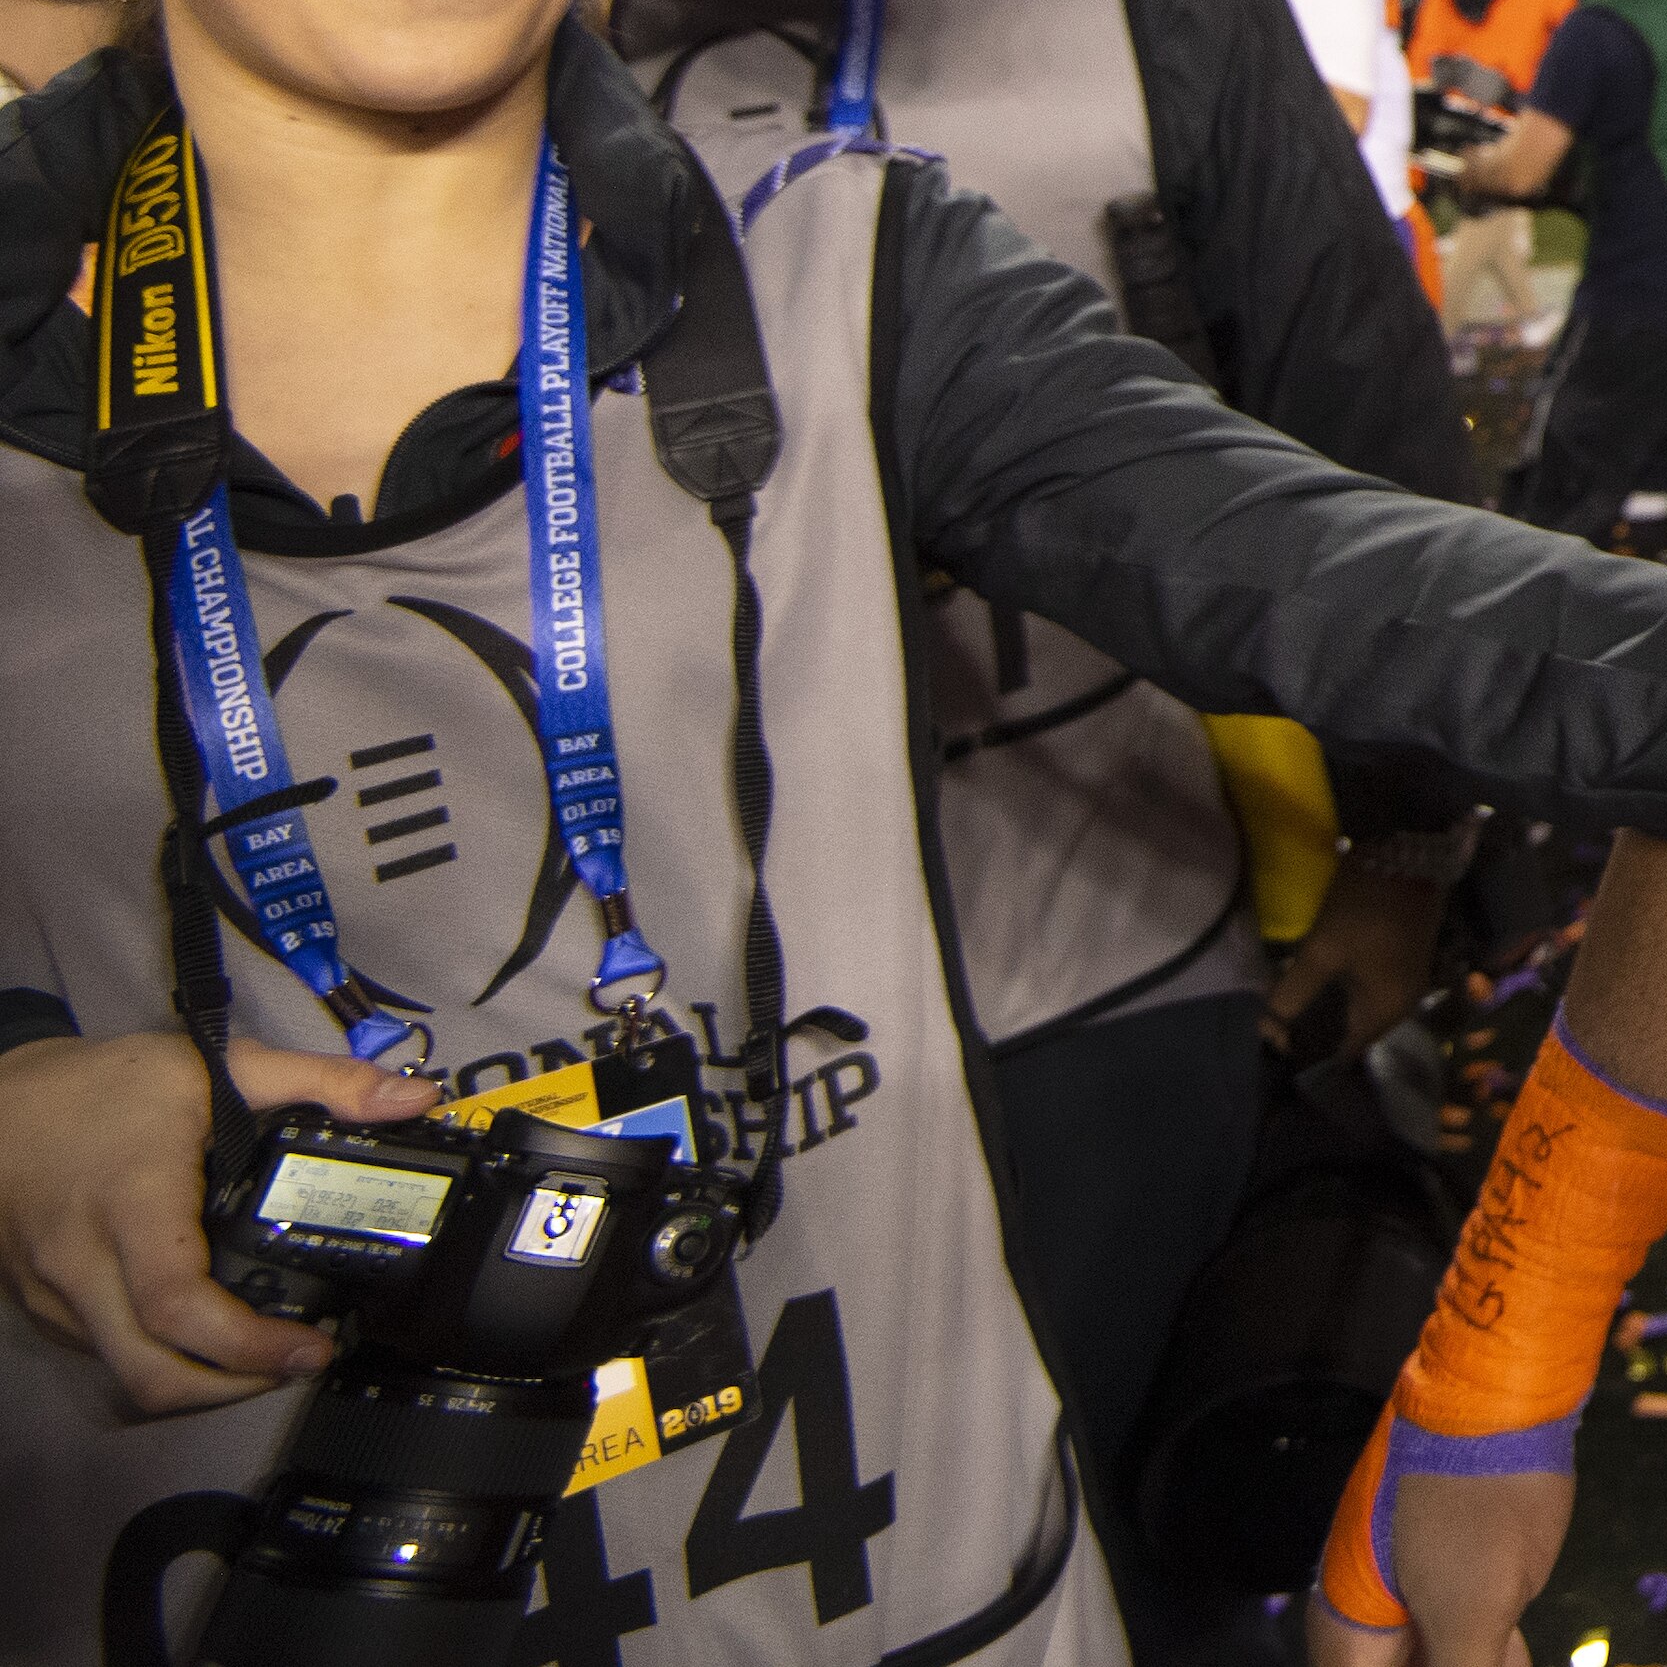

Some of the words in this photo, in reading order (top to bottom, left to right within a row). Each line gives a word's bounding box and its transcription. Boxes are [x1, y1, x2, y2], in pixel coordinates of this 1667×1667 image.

[119, 134, 186, 278] D500
[540, 172, 570, 282] NATIONAL
[132, 283, 180, 397] Nikon
[540, 282, 572, 392] PLAYOFF
[541, 395, 580, 547] FOOTBALL
[550, 550, 588, 693] COLLEGE
[190, 546, 269, 781] CHAMPIONSHIP
[556, 732, 600, 754] BAY
[555, 765, 616, 790] AREA
[562, 796, 618, 823] 01.07
[247, 823, 293, 852] BAY
[571, 827, 622, 856] 219
[253, 857, 316, 887] AREA
[263, 890, 324, 920] 01.07
[281, 921, 337, 953] 219
